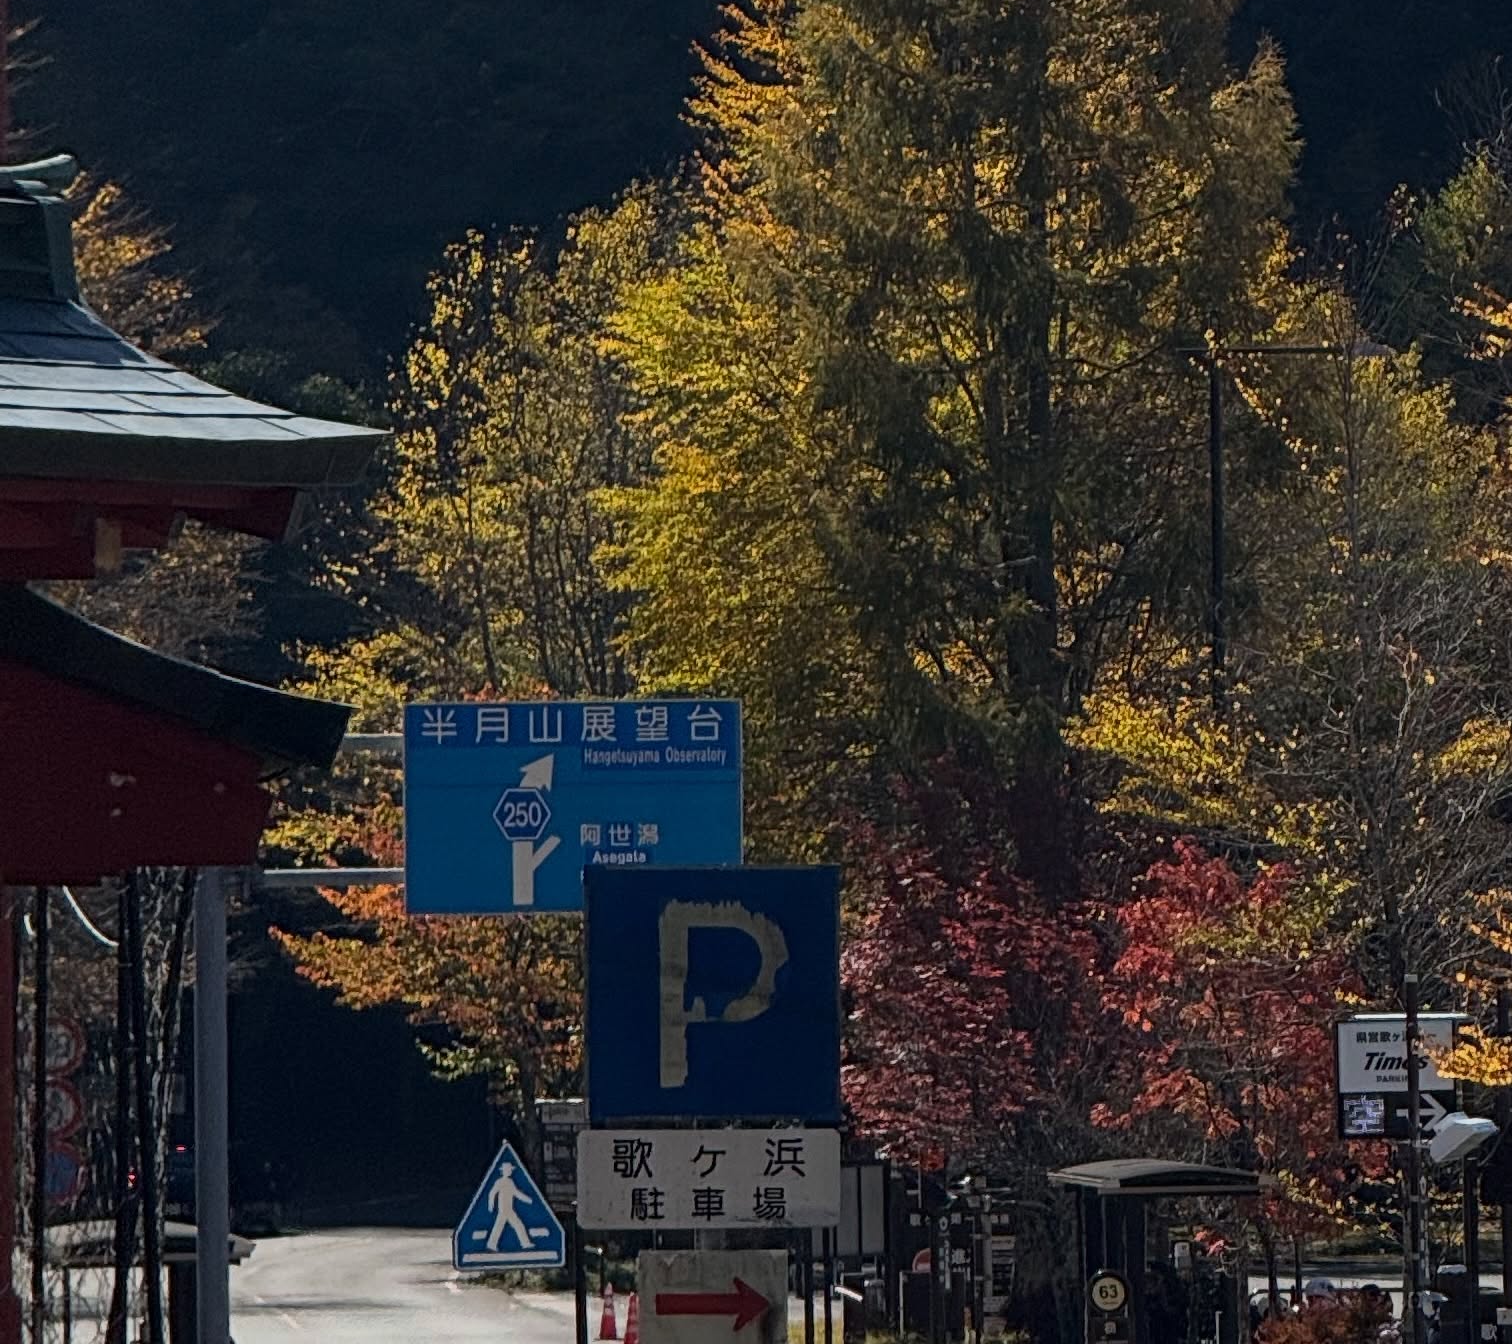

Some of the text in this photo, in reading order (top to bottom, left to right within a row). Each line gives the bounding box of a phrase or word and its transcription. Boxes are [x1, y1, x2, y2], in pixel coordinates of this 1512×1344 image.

[421, 704, 723, 744] 半月山展望台
[584, 745, 727, 767] Hangetsuyama Observatory
[503, 802, 541, 828] 250
[659, 898, 788, 1087] P
[630, 1187, 787, 1221] 駐車場
[1099, 1284, 1119, 1299] 63
